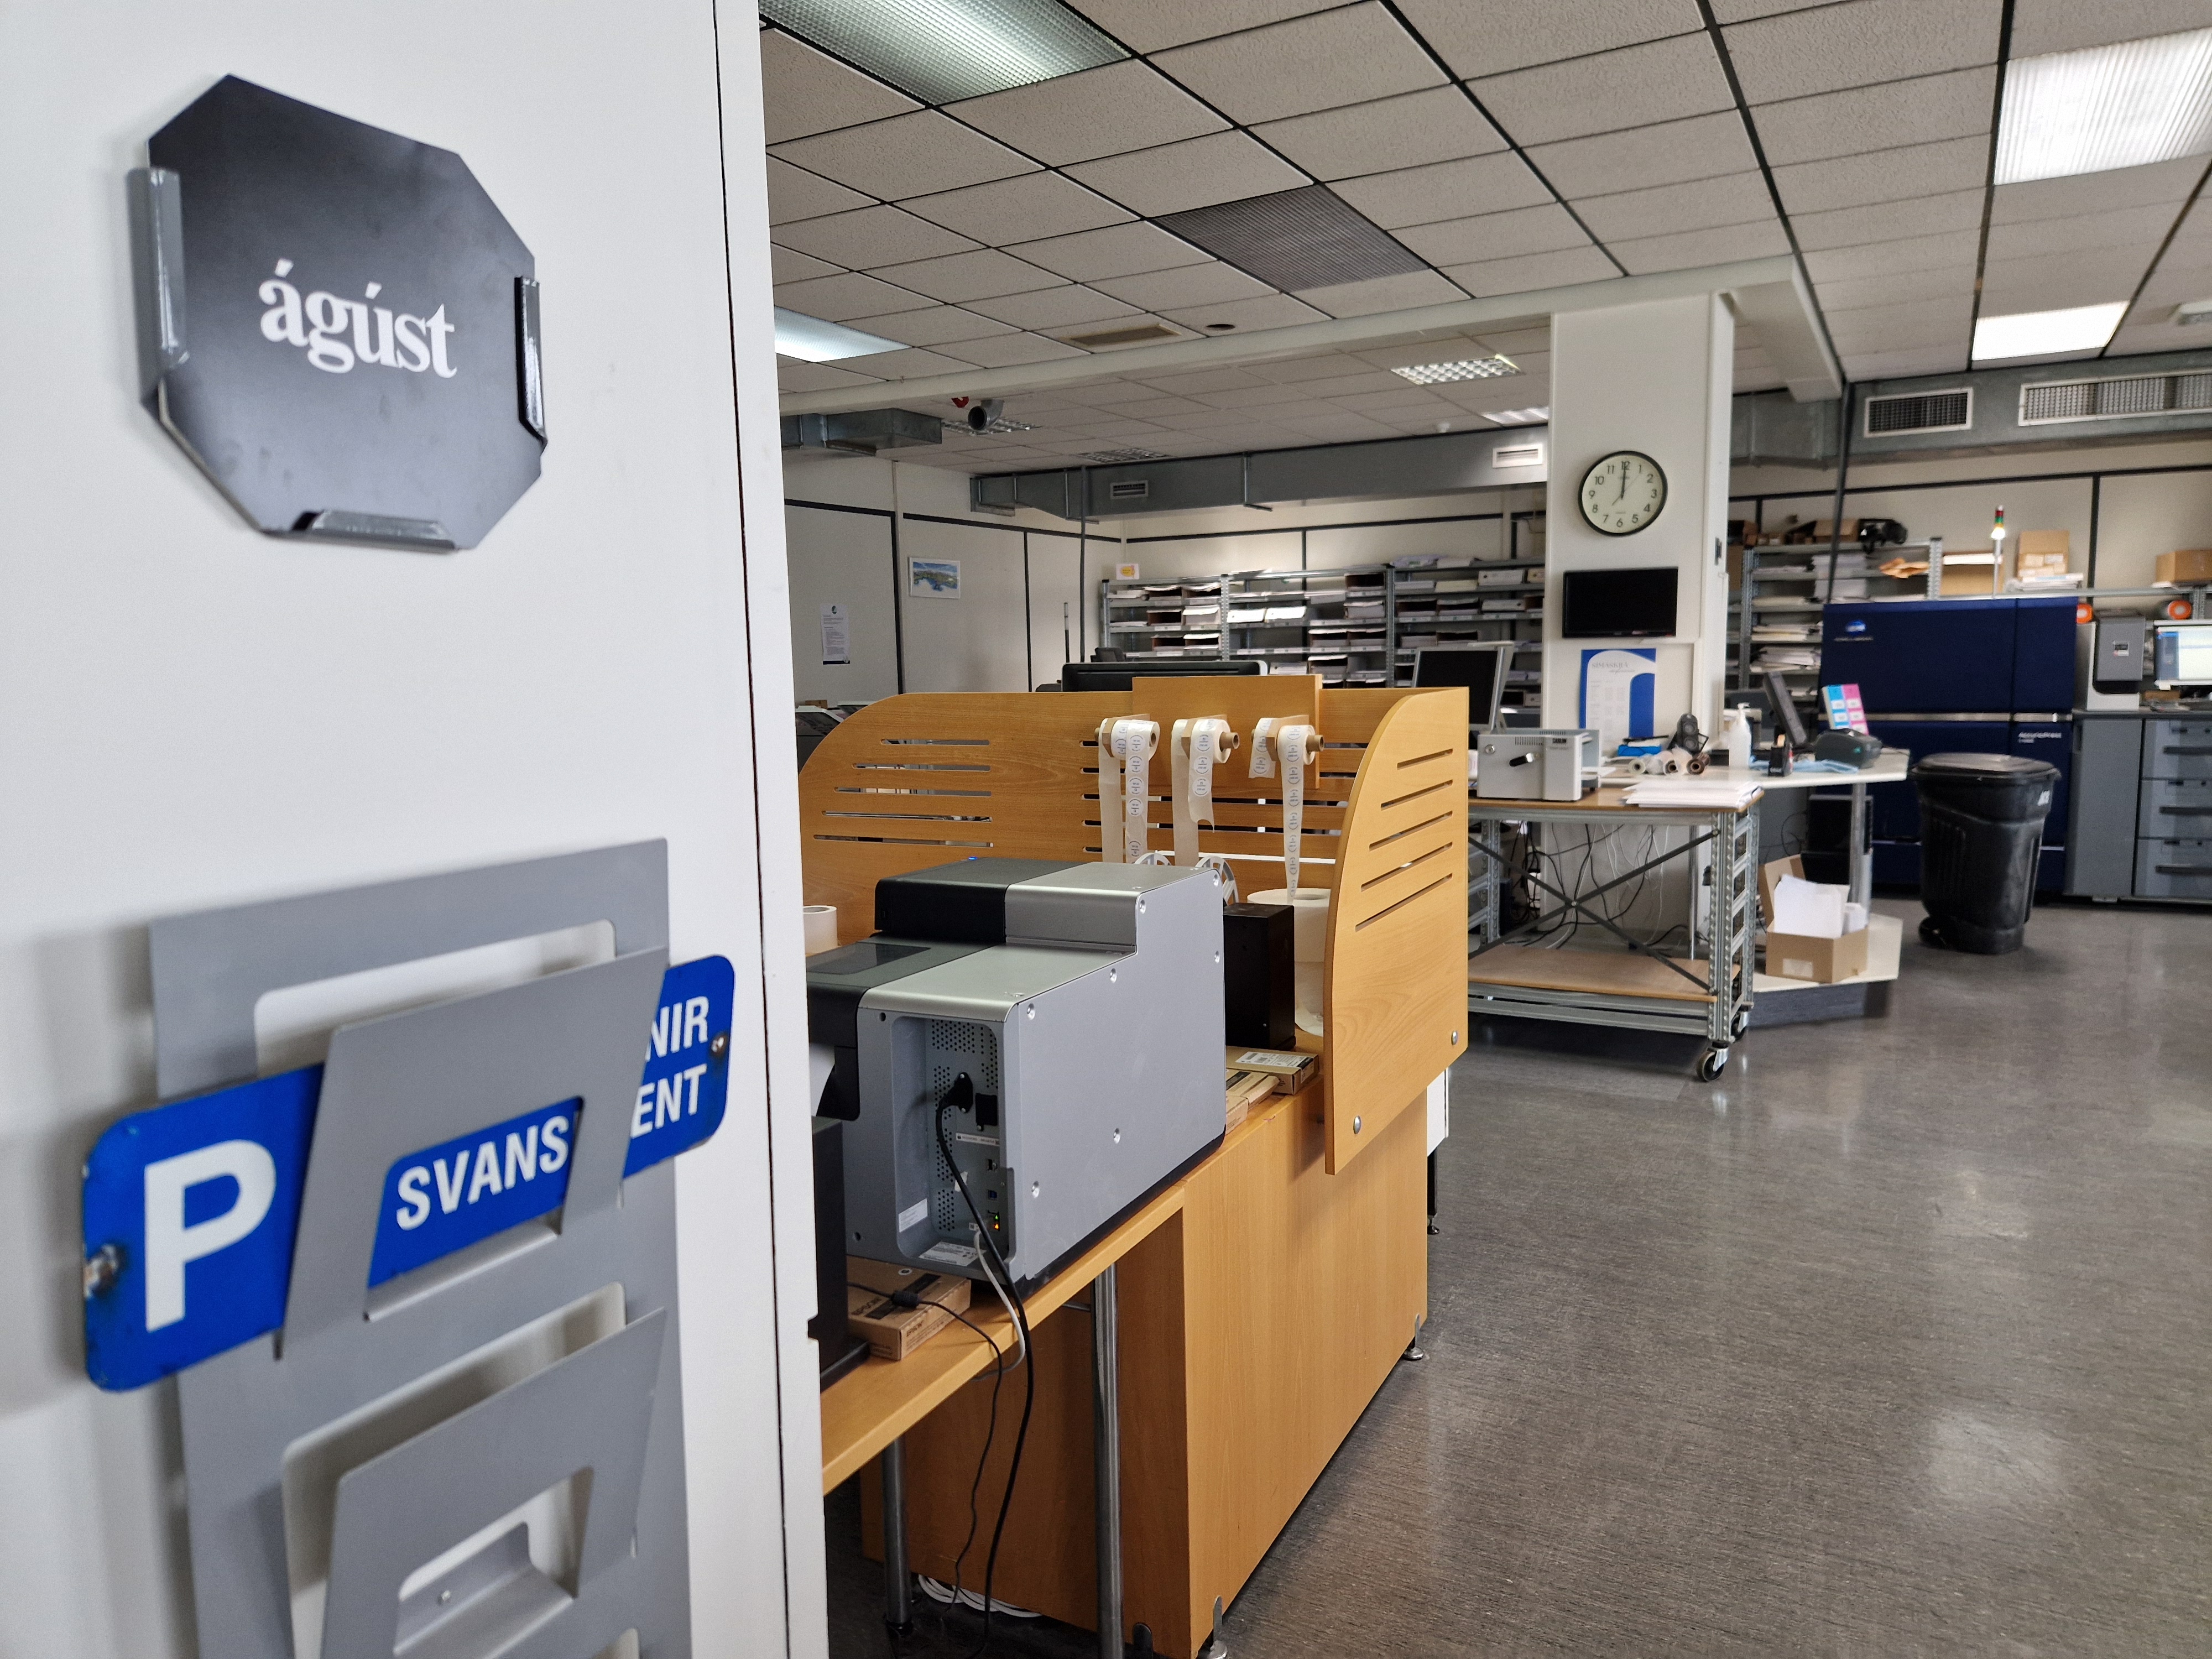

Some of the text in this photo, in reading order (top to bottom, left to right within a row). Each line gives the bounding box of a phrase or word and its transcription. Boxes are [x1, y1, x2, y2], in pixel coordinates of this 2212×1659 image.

[258, 257, 457, 378] ágúst
[1607, 465, 1614, 474] 11
[1639, 465, 1642, 473] 1
[1595, 476, 1604, 485] 10
[1647, 474, 1653, 483] 2
[1589, 490, 1595, 499] 9
[1651, 489, 1657, 499] 3
[1592, 504, 1598, 513] 8
[1643, 503, 1651, 513] 4
[1603, 514, 1609, 523] 7
[1616, 518, 1623, 528] 6
[1631, 514, 1639, 524] 5
[144, 1139, 277, 1333] P
